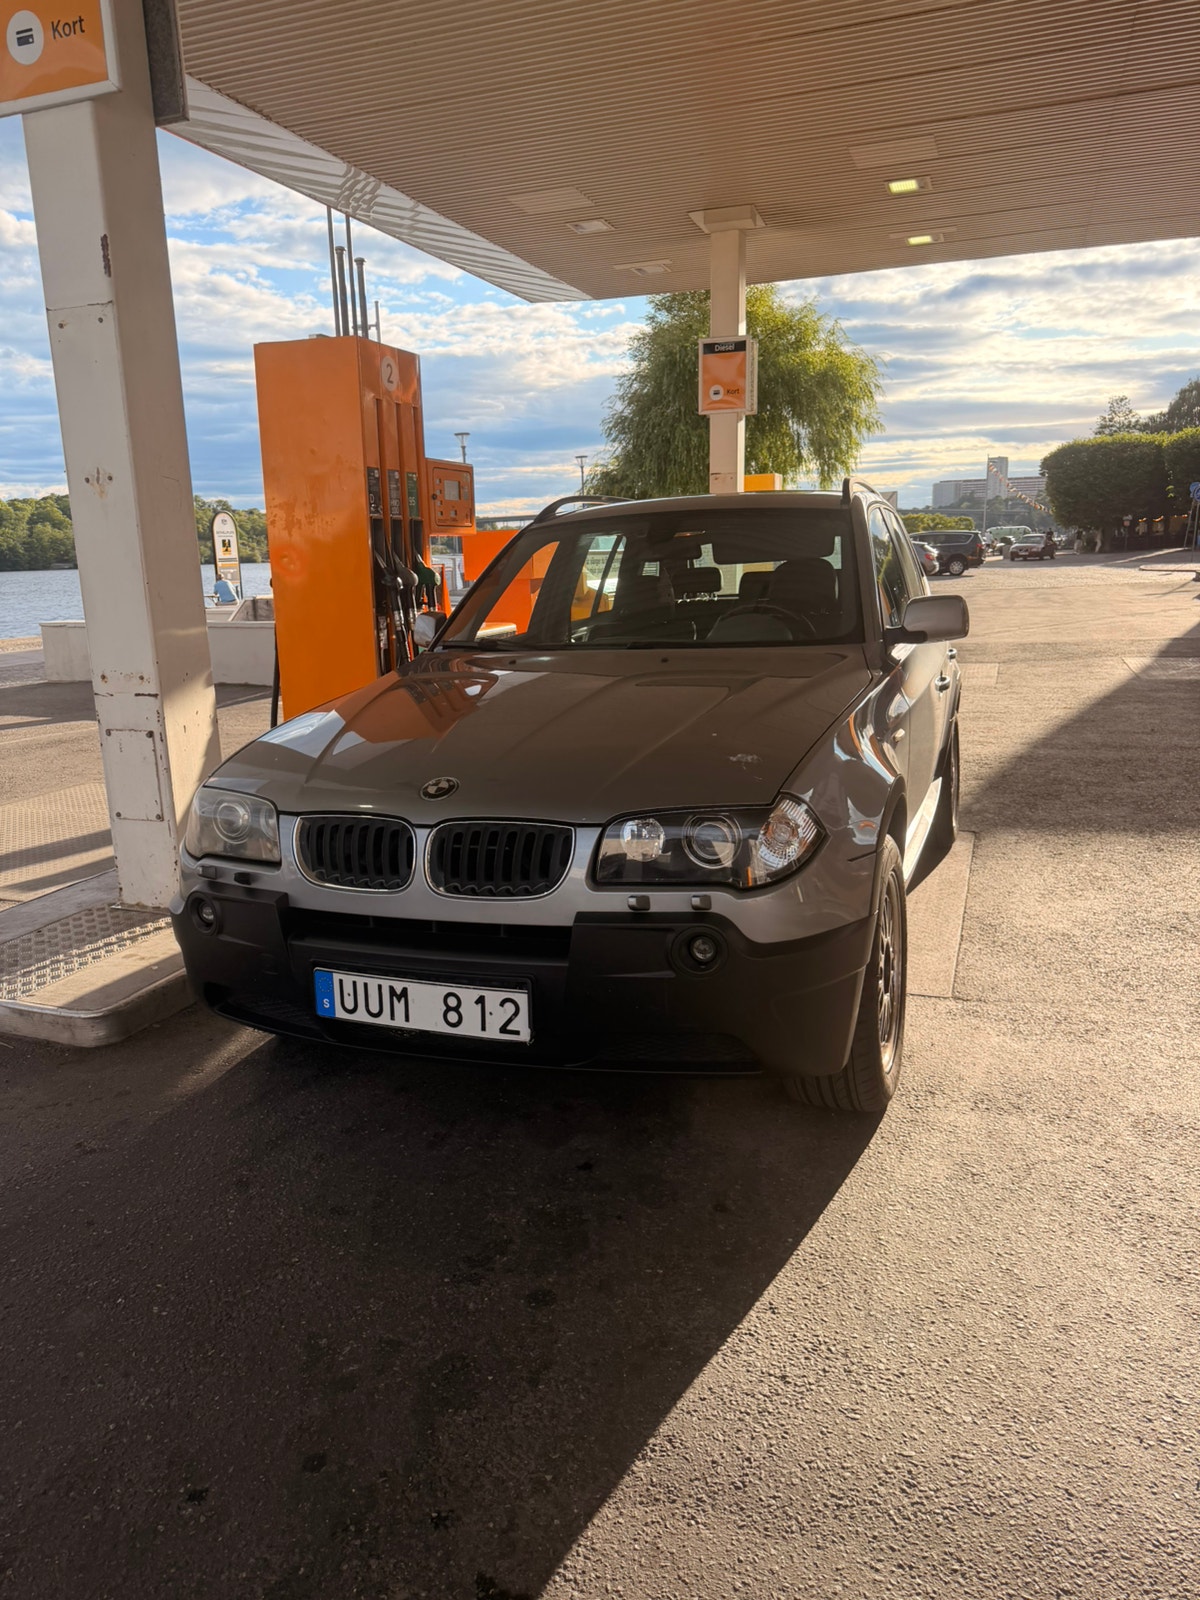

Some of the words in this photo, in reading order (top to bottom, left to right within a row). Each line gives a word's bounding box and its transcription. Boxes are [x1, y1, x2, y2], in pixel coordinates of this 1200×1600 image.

[51, 16, 85, 39] Kort
[715, 343, 735, 351] Diesel
[386, 363, 394, 384] 2
[323, 998, 330, 1008] S
[339, 978, 410, 1022] UUM
[442, 991, 521, 1036] 812
